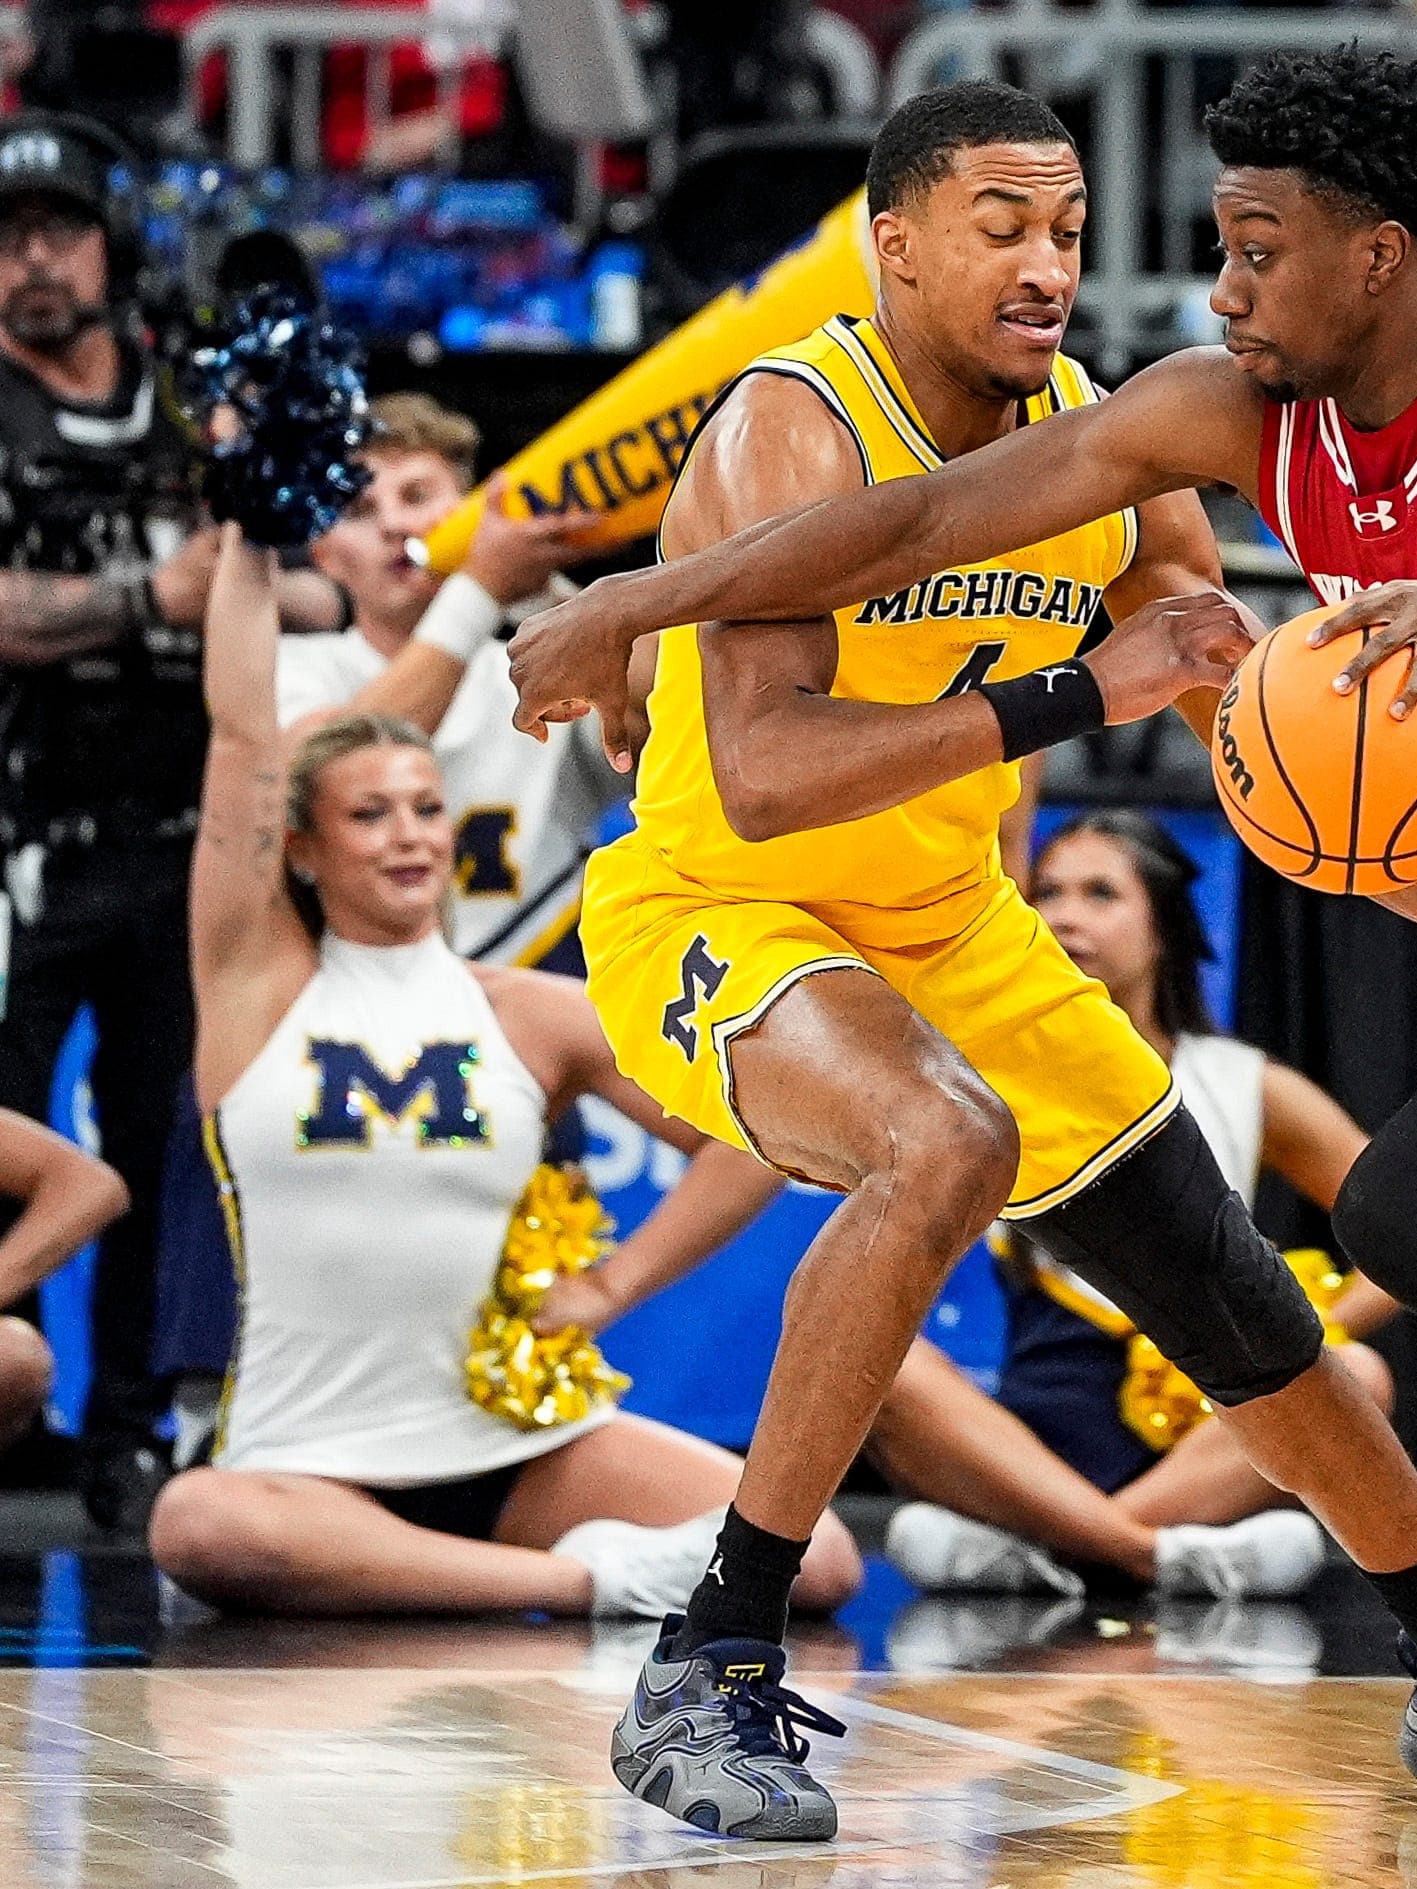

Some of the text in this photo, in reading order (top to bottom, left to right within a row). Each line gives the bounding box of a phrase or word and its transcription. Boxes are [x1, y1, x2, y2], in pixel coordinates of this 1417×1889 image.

[852, 569, 1106, 628] MICHIGAN
[660, 931, 731, 1066] M
[297, 1034, 494, 1154] M
